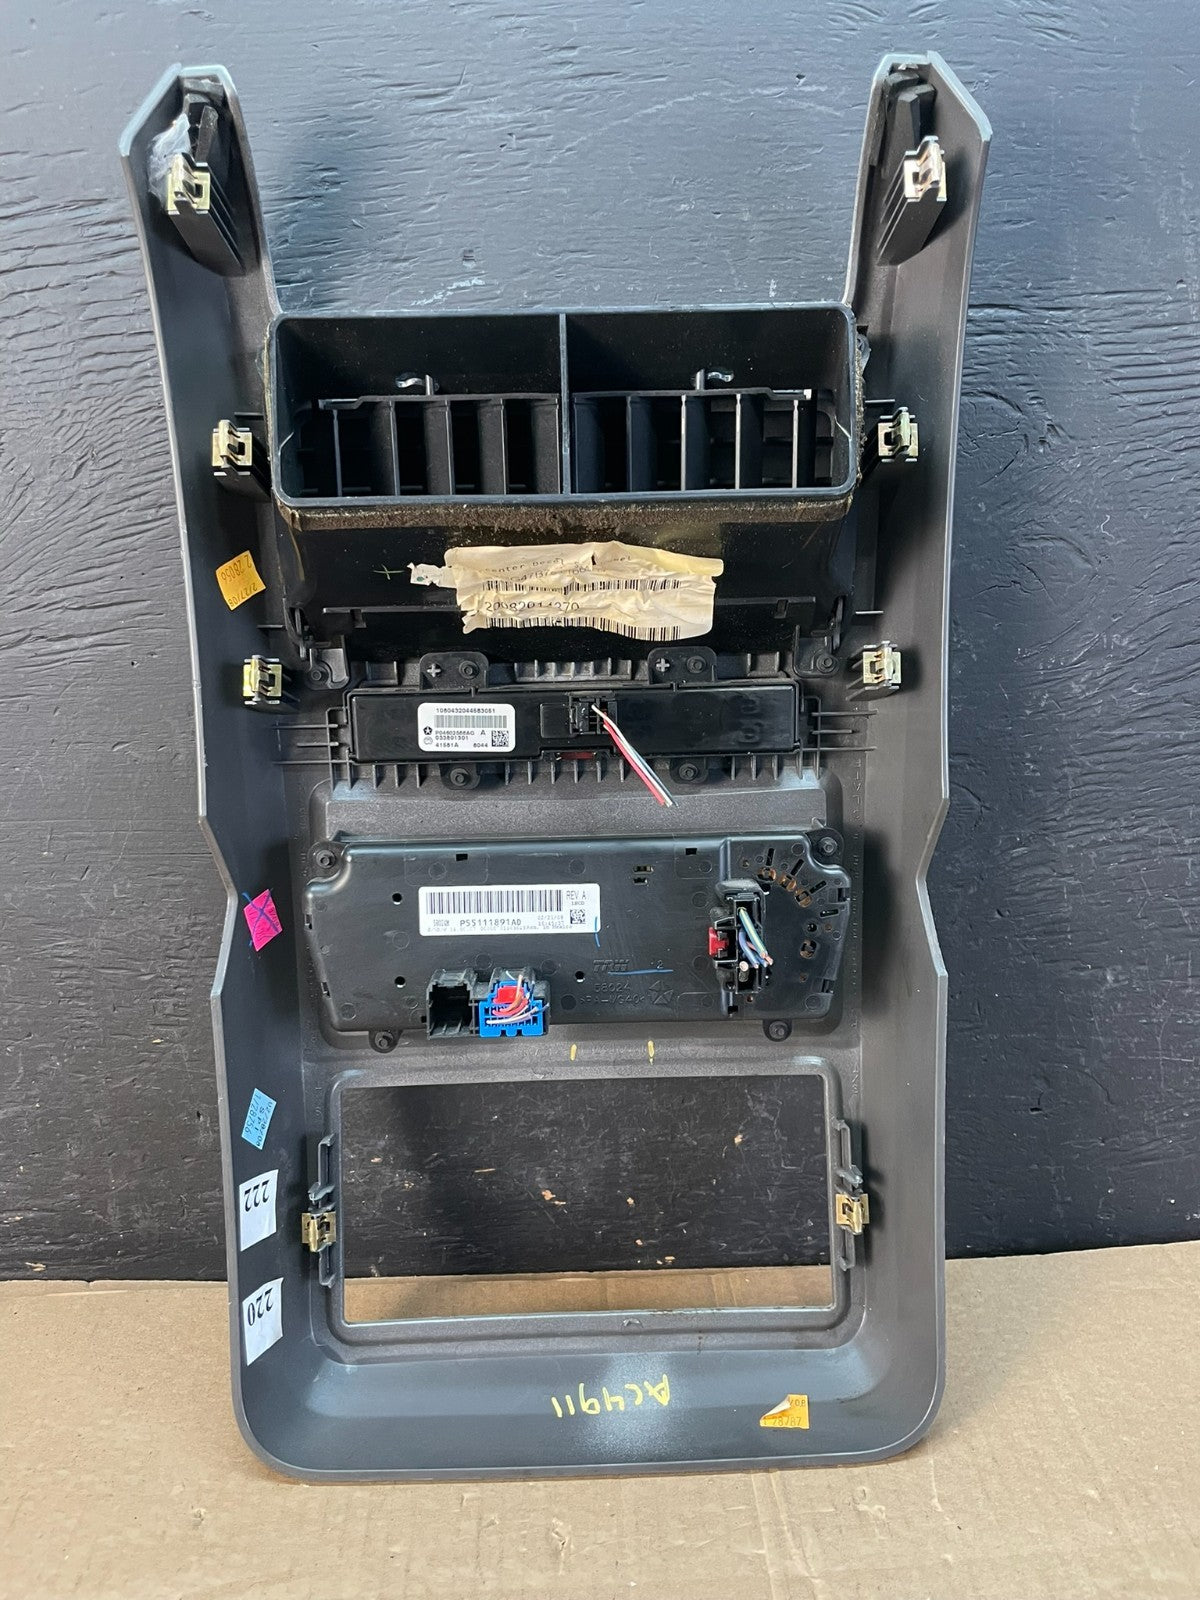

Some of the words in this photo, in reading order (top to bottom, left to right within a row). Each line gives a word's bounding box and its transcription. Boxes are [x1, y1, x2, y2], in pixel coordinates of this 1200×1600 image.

[566, 890, 580, 900] REV
[593, 959, 630, 972] TRW
[243, 1179, 270, 1213] 222
[247, 1286, 273, 1327] 220
[550, 1373, 671, 1418] AC4911
